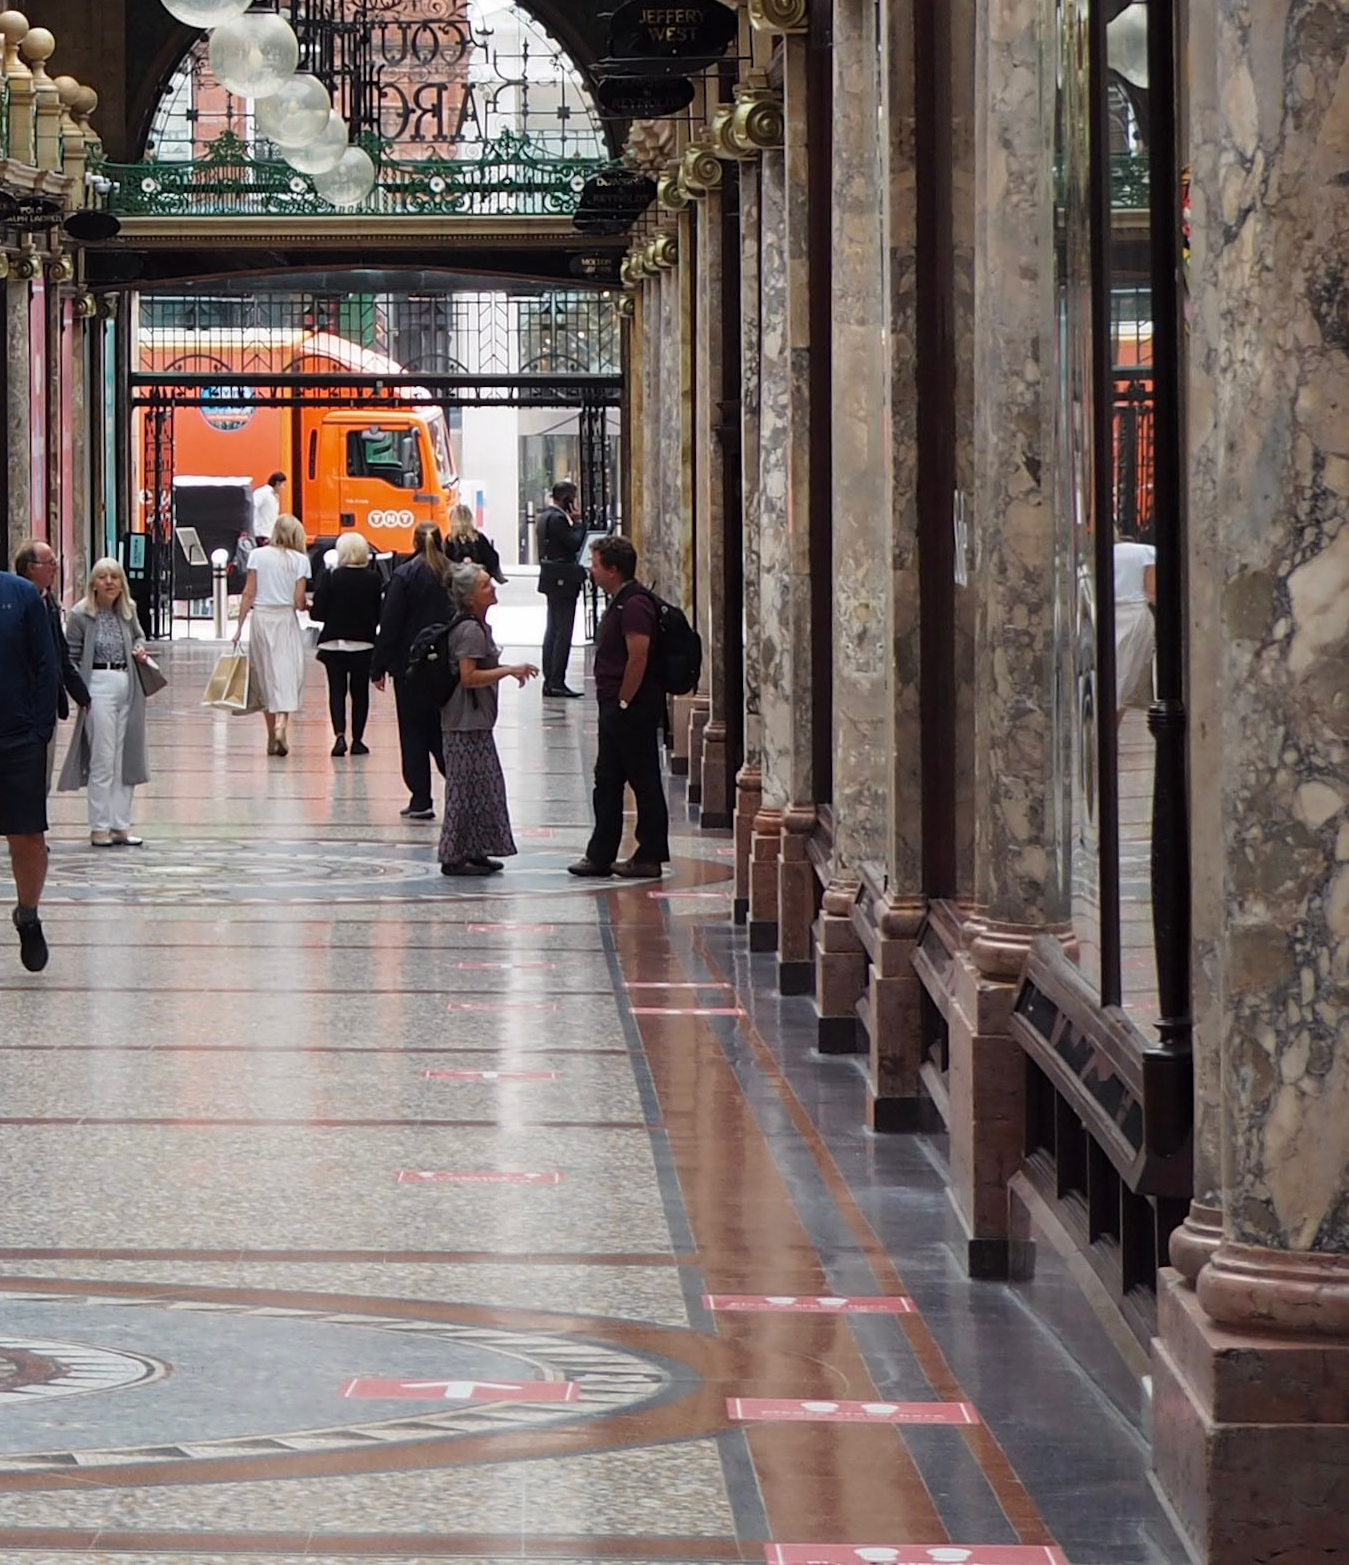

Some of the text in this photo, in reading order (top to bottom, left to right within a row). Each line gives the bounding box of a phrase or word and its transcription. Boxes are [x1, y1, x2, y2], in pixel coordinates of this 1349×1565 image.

[639, 9, 705, 24] JEFFERY
[648, 27, 698, 41] WEST
[370, 512, 412, 526] TNT
